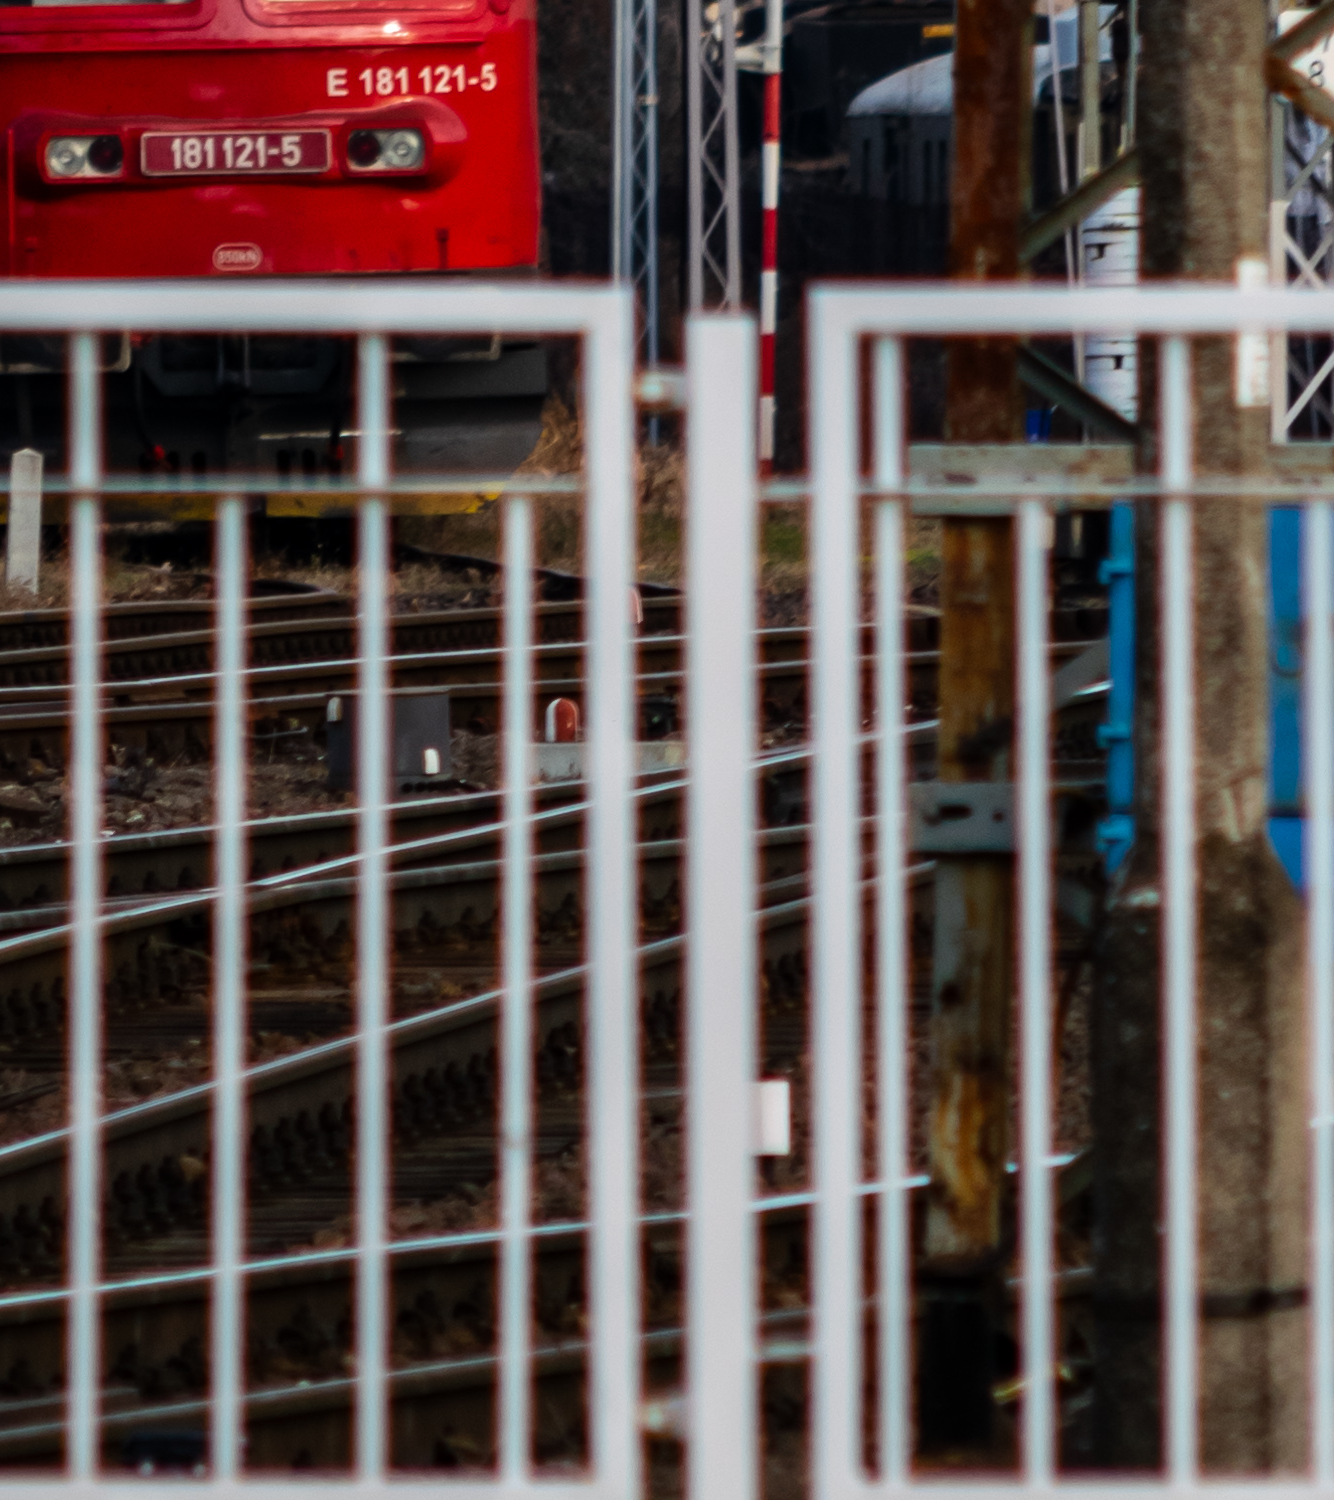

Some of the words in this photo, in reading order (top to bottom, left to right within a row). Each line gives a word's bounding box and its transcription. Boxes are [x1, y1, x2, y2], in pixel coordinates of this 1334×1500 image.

[327, 69, 348, 96] E
[358, 67, 409, 95] 181
[418, 63, 498, 94] 121-5
[171, 138, 215, 170] 181
[222, 135, 301, 168] 121-5
